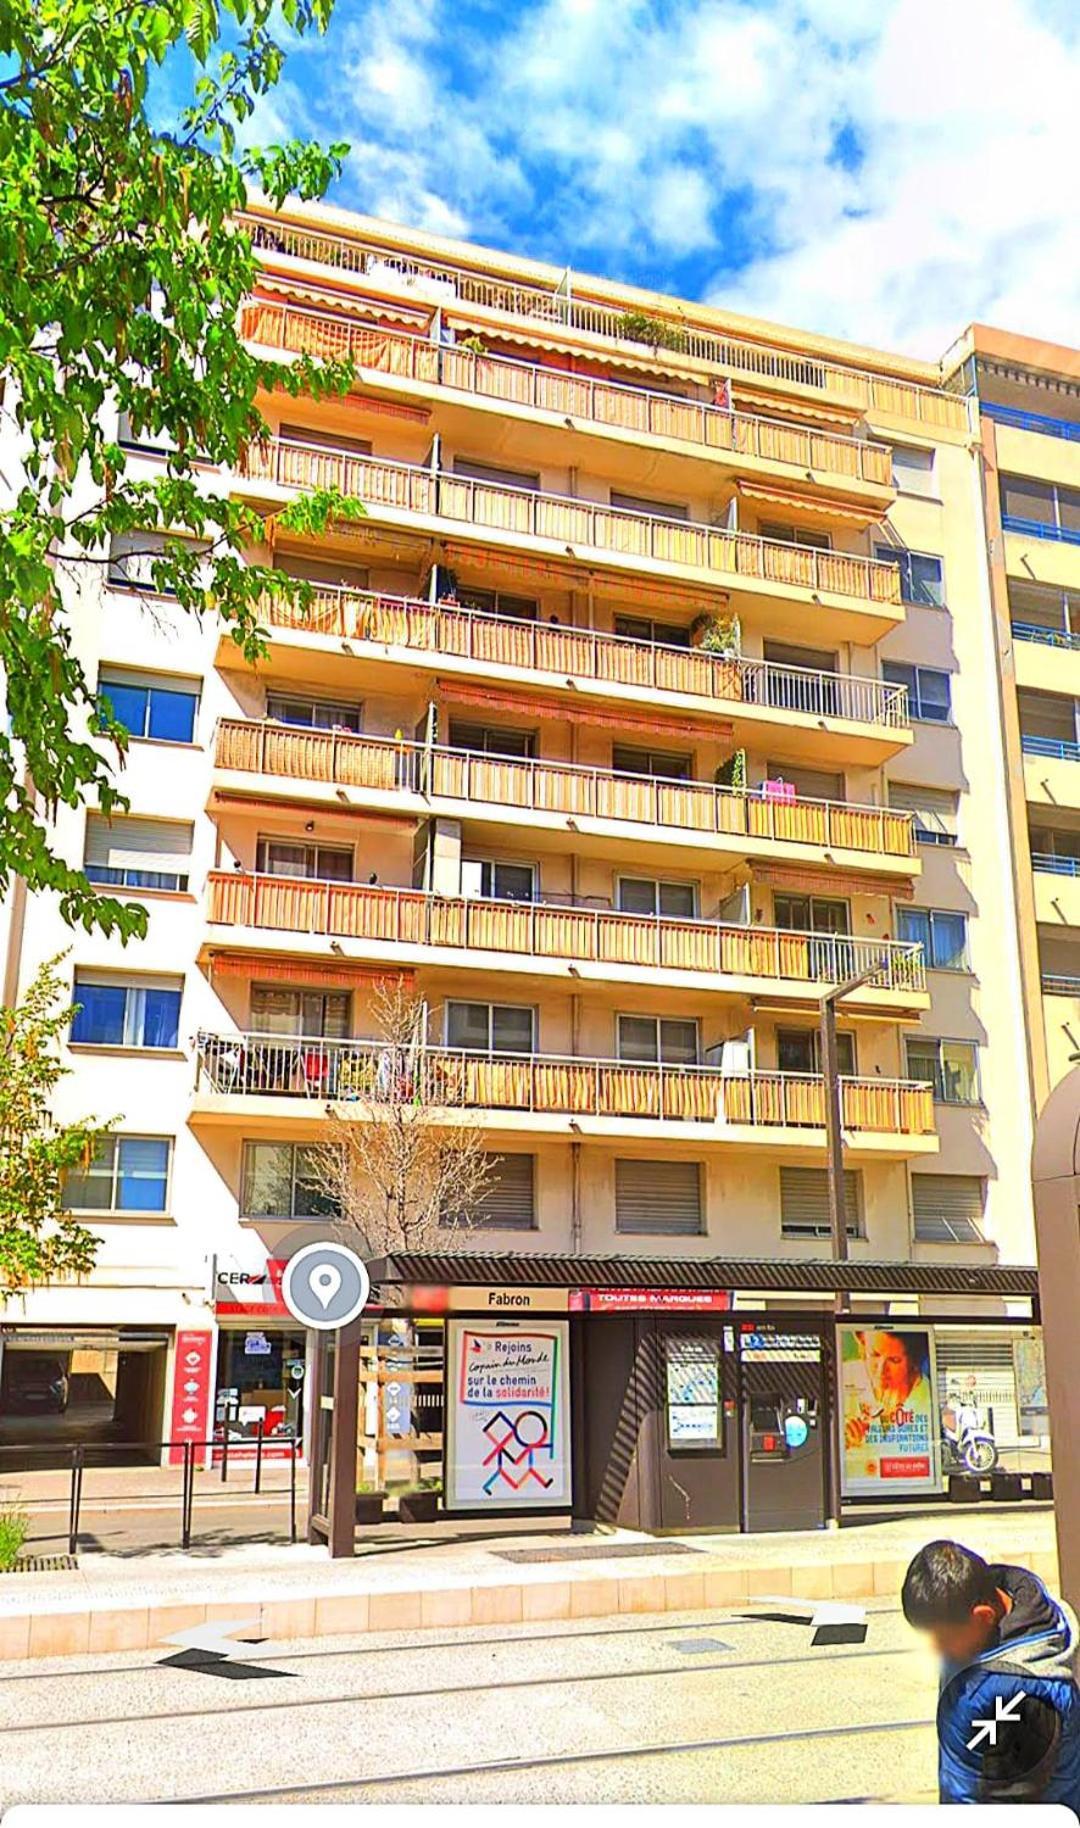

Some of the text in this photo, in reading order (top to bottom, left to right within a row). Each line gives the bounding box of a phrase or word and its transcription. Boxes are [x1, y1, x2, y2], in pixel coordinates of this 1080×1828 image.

[488, 1292, 530, 1306] Fabron
[598, 1294, 713, 1303] TOUTES MARQUES
[495, 1341, 532, 1355] Rejoins
[469, 1351, 549, 1374] Copain du Monde
[467, 1375, 536, 1385] sur le chemin
[467, 1387, 480, 1398] de
[483, 1387, 493, 1398] la
